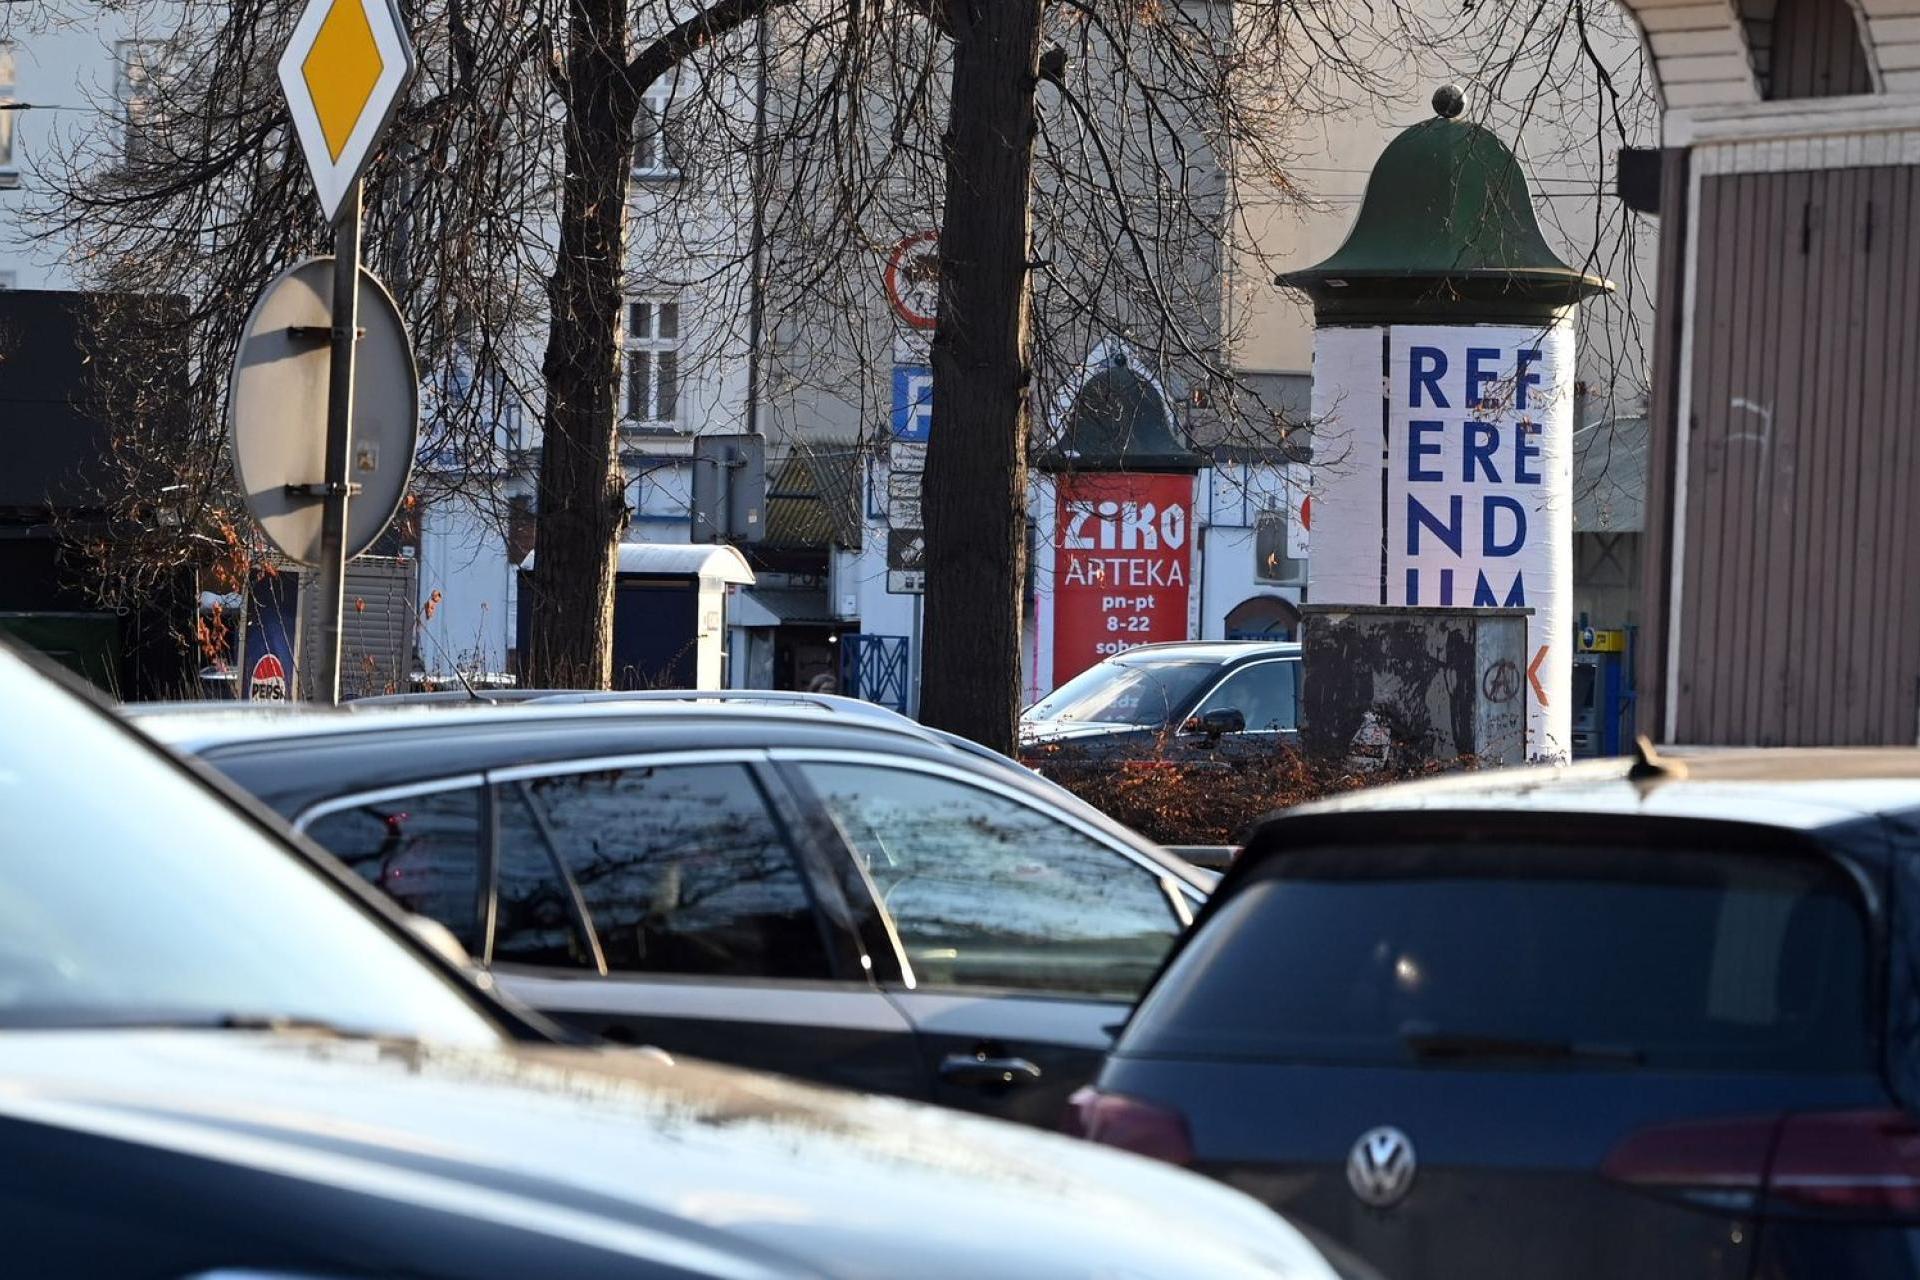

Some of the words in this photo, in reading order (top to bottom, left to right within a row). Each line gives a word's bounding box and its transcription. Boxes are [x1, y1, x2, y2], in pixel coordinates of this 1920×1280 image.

[1408, 346, 1543, 409] REF
[1407, 420, 1542, 484] ERE
[1406, 493, 1527, 558] ND
[1064, 558, 1184, 586] APTEKA
[1102, 595, 1155, 612] pn-pt
[1106, 616, 1150, 632] 8-22
[1096, 640, 1148, 654] sob
